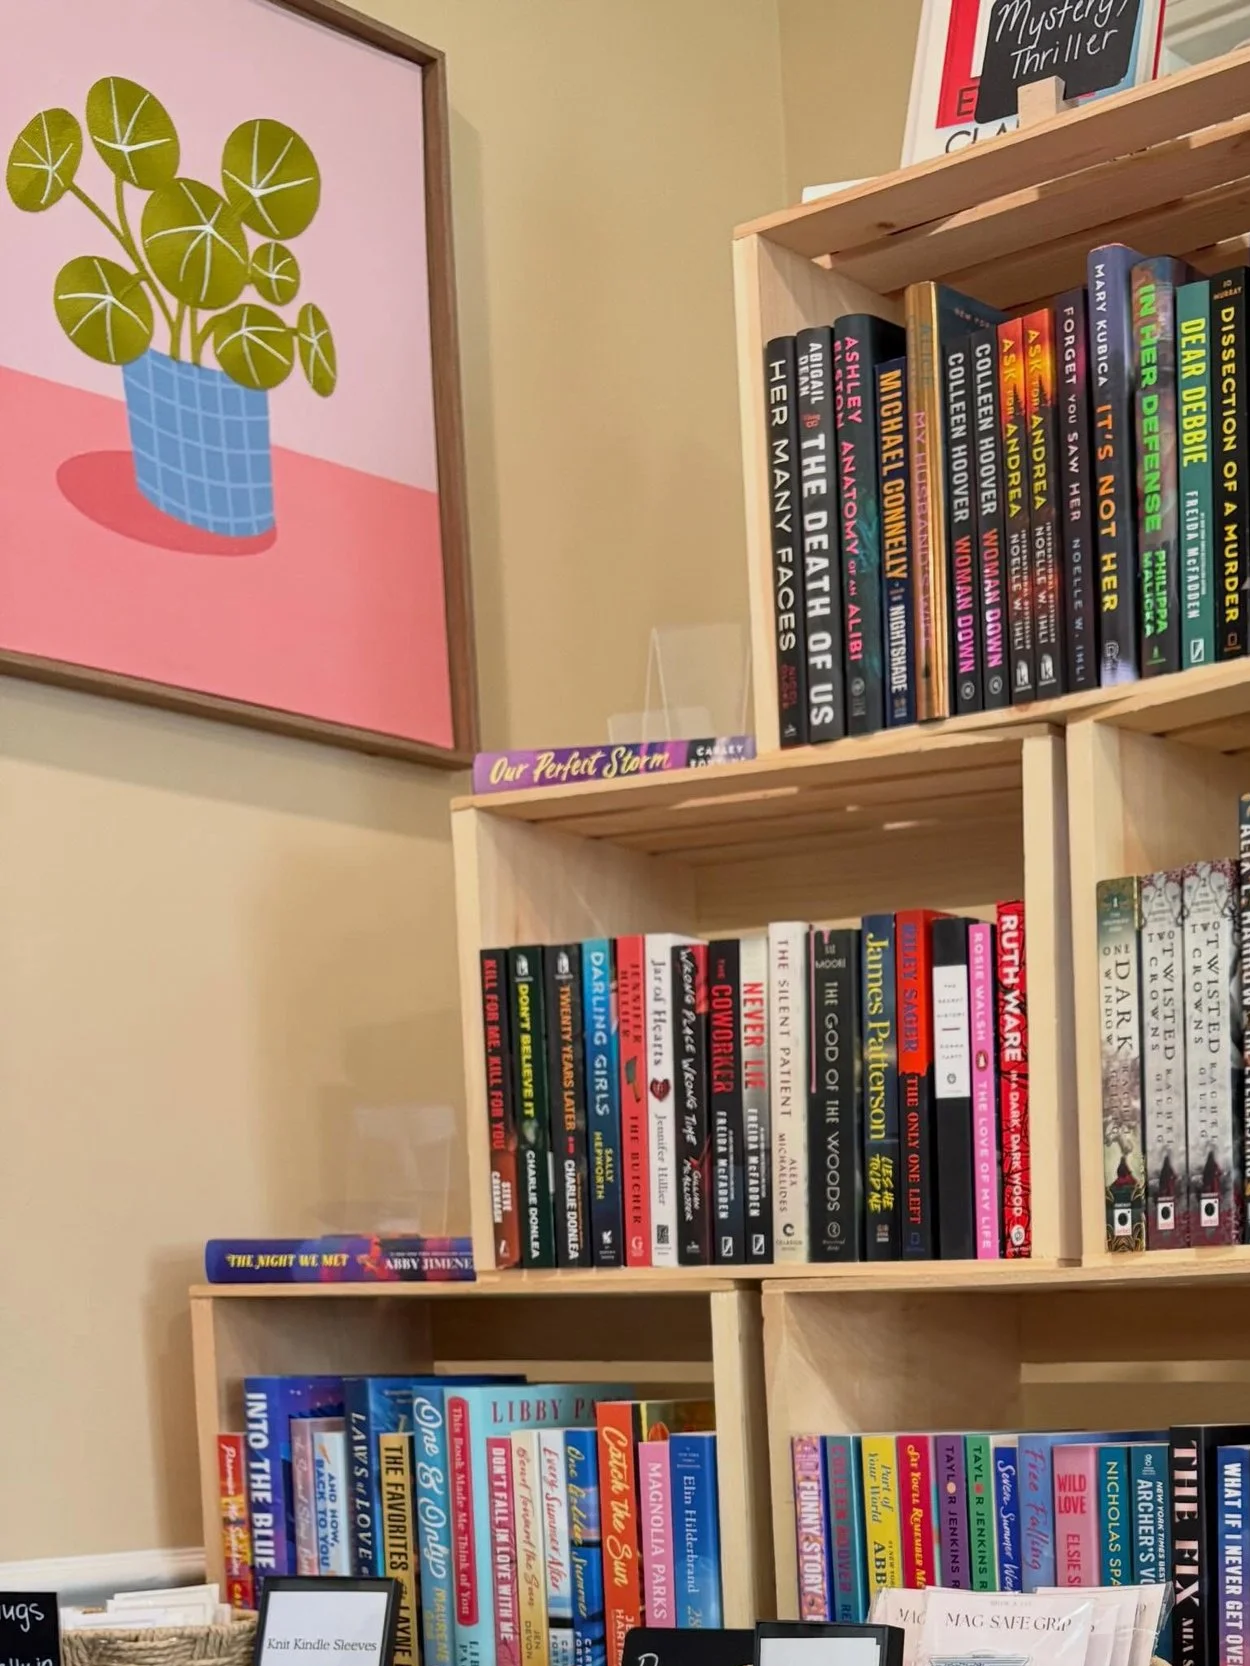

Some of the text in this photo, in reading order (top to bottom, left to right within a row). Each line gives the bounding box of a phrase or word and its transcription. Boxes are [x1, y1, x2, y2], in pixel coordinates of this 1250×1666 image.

[1011, 29, 1118, 79] Thriller
[769, 359, 788, 426] HER
[1094, 264, 1109, 387] MARY KUBICA
[1181, 317, 1208, 467] DEAR DEBBIE
[772, 438, 792, 533] MANY
[1063, 306, 1081, 521] FORGET YOU SAW HER
[1137, 284, 1161, 533] IN HER DEFENSE
[1221, 307, 1239, 623] DISSECTION OF A MURDER
[801, 433, 834, 727] THE DEATH OF US
[880, 369, 907, 693] MICHAEL CONNELLY NIGHTSHADE
[948, 352, 975, 673] COLLEEN HOOVER WOMAN DOWN
[1096, 404, 1119, 613] IT'S NOT HER
[776, 547, 796, 651] FACES
[489, 757, 530, 785] Our
[533, 750, 606, 782] Perfect
[590, 951, 610, 1117] DARLING GIRLS
[711, 984, 734, 1095] COWORKER
[867, 932, 891, 1141] James Patterson
[1001, 915, 1021, 1063] RUTH WARE
[227, 1253, 420, 1271] THE NIGHT WE MET ABBY
[245, 1392, 276, 1570] INTO THE BLUE
[648, 1461, 668, 1620] MAGNOLIA PARKS
[1173, 1444, 1199, 1607] THE FIX
[267, 1638, 377, 1652] Knit Kindle Sleeves
[945, 1613, 1072, 1633] MAG SAFE GRIP
